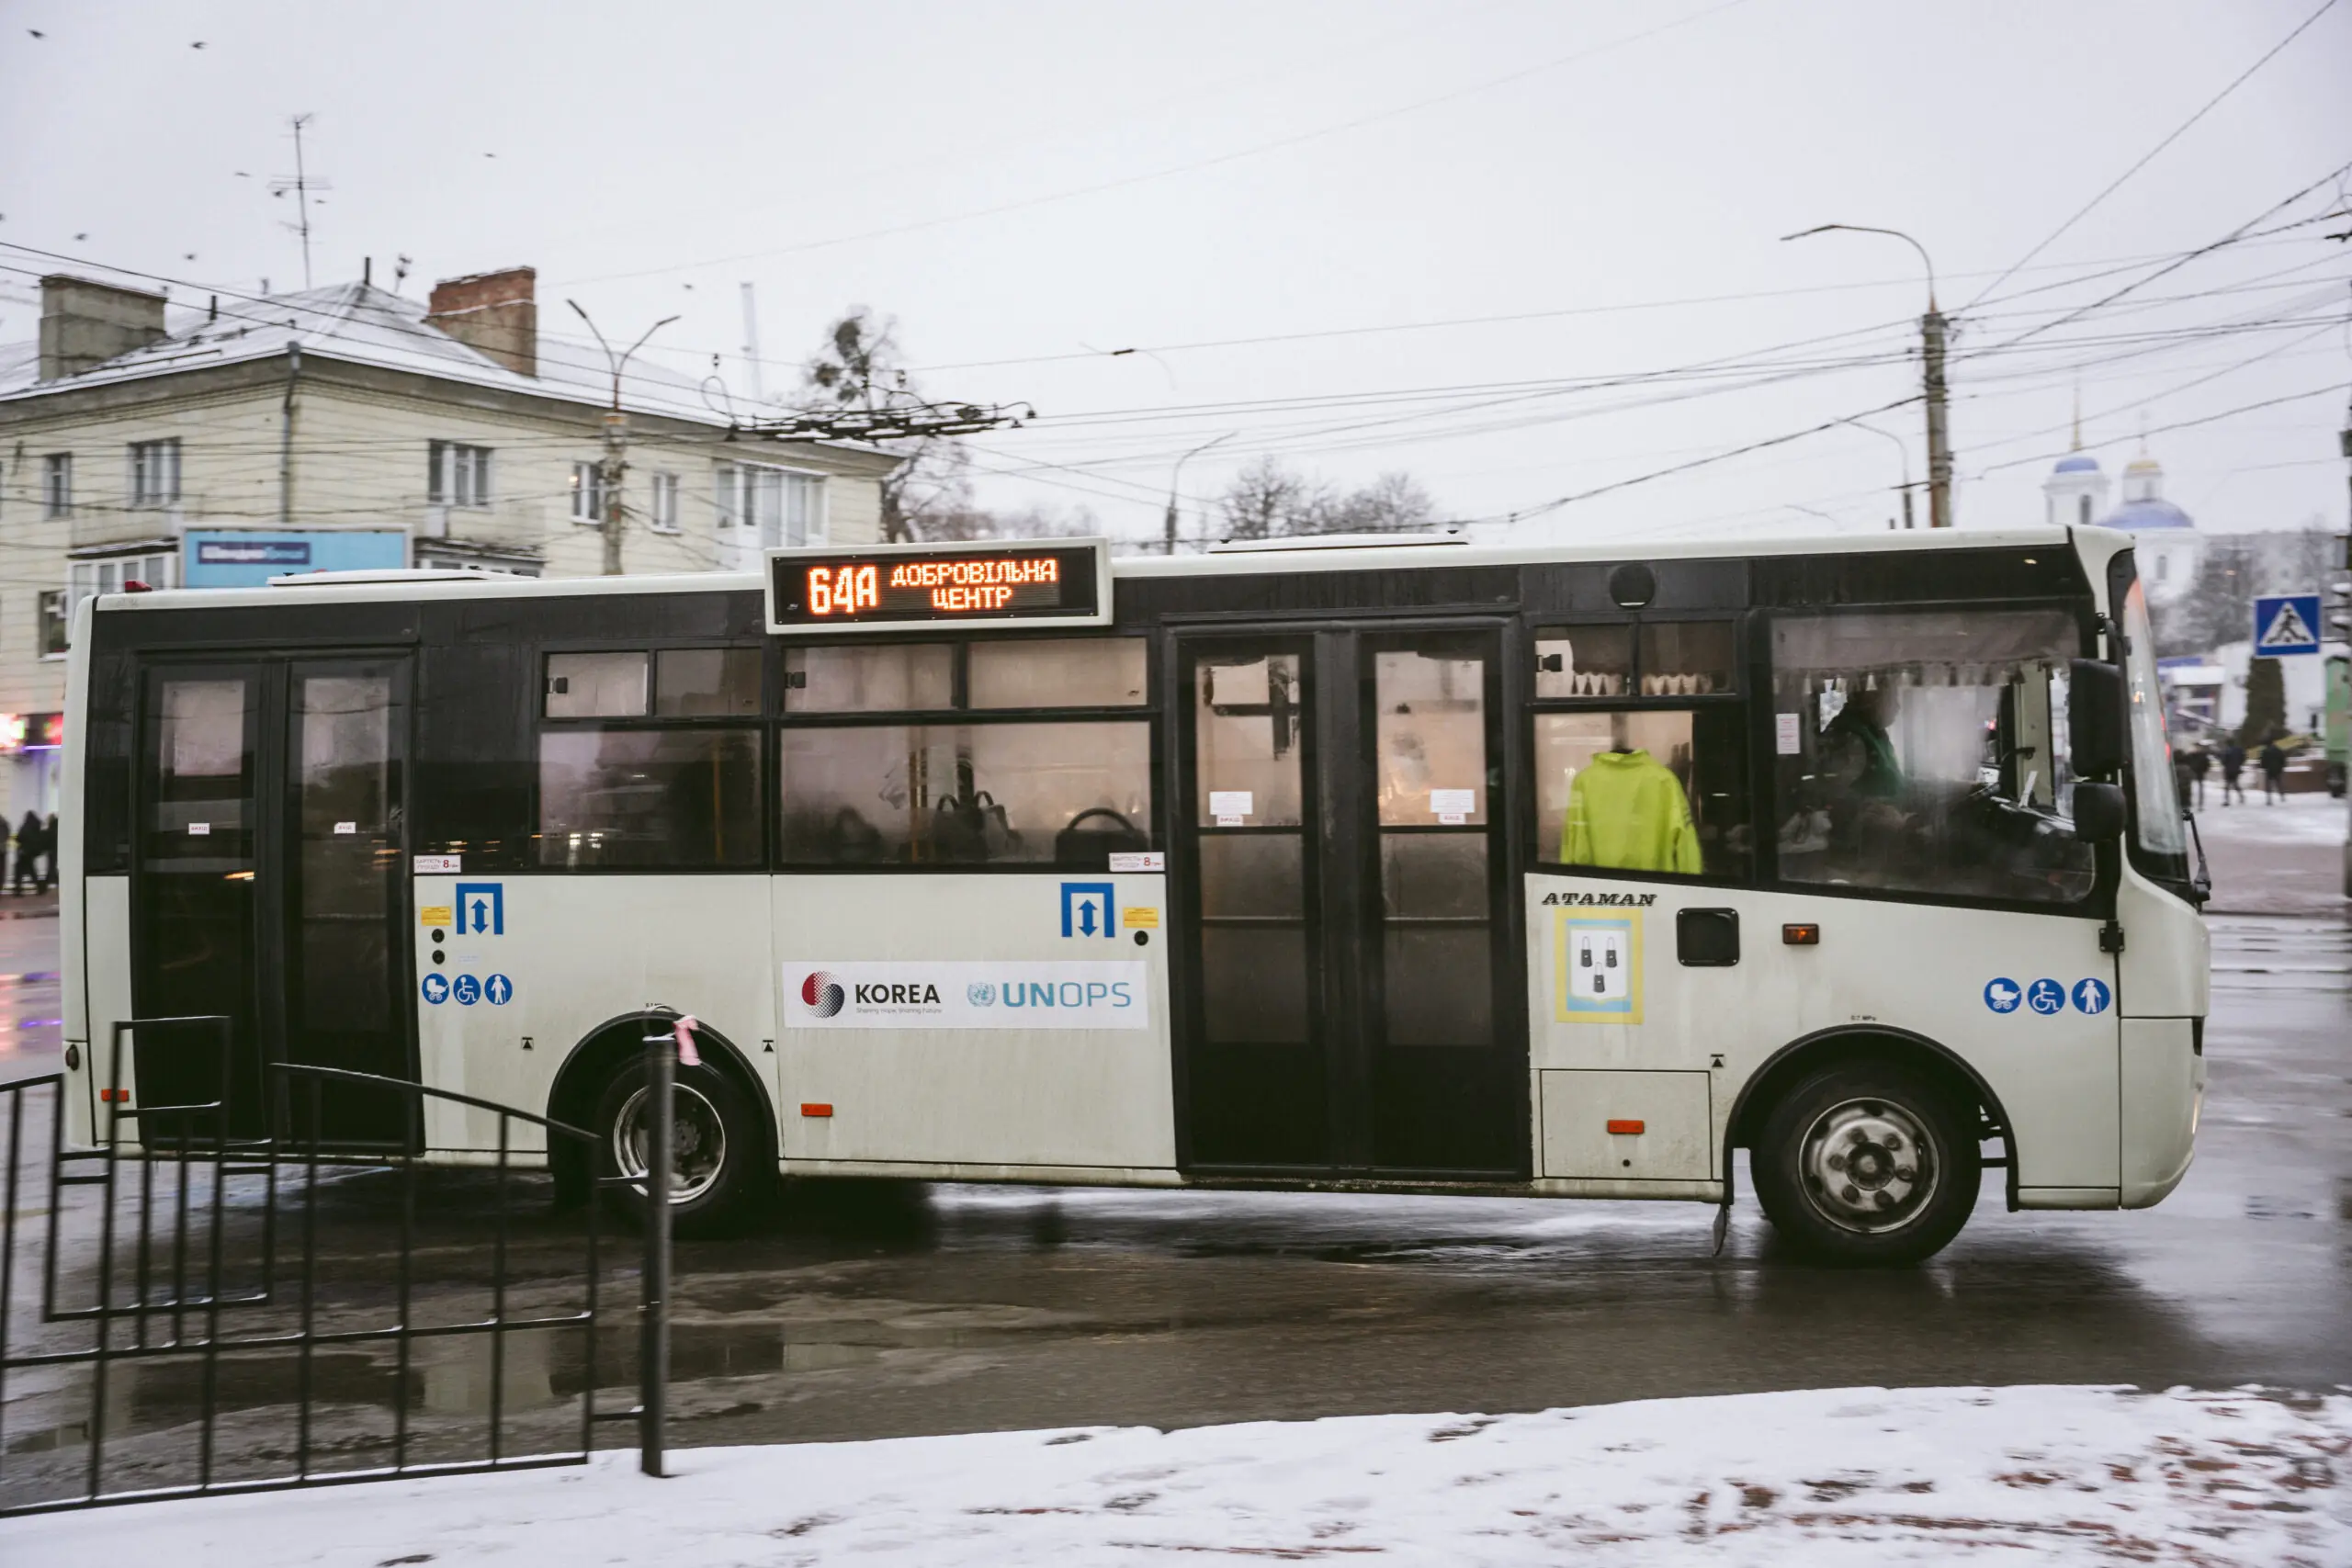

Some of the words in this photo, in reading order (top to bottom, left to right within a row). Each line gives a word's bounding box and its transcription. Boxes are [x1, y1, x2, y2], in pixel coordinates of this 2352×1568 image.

[808, 566, 879, 614] 64А
[890, 558, 1057, 587] ДОБРОВІЛЬНА
[932, 586, 1012, 610] ЦЕНТР
[443, 859, 449, 868] 8
[1143, 856, 1150, 866] 8
[1542, 892, 1657, 907] ATAMAN
[854, 984, 941, 1004] KOREA
[1002, 982, 1131, 1008] UNOPS
